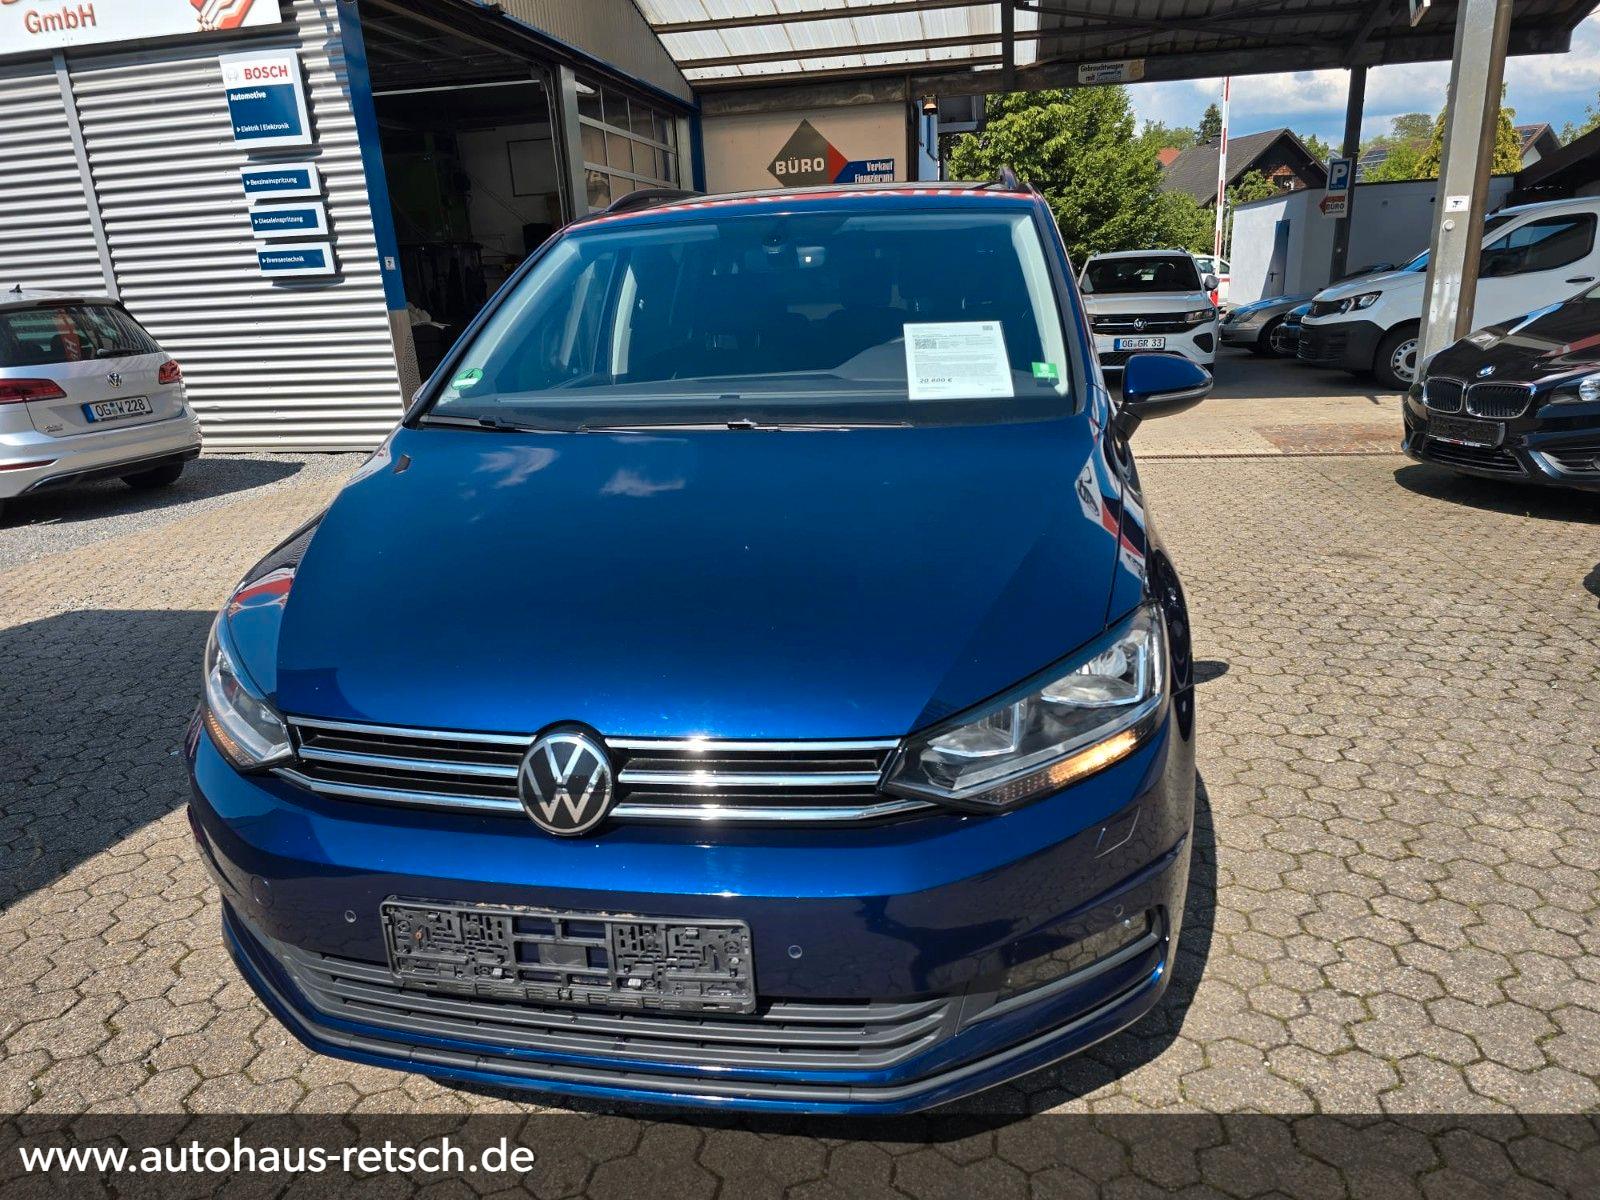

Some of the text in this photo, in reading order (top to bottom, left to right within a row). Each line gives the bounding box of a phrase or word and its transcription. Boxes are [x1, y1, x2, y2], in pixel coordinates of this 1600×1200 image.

[24, 3, 97, 34] GmbH
[244, 65, 289, 80] BOSCH
[230, 91, 267, 102] Automotive
[263, 123, 290, 131] Elektronik
[775, 157, 825, 175] BÜRO
[866, 160, 893, 172] Verkauf
[1331, 163, 1348, 185] P
[1122, 338, 1162, 348] OG GR 33
[95, 403, 112, 417] OG
[125, 398, 146, 413] 228
